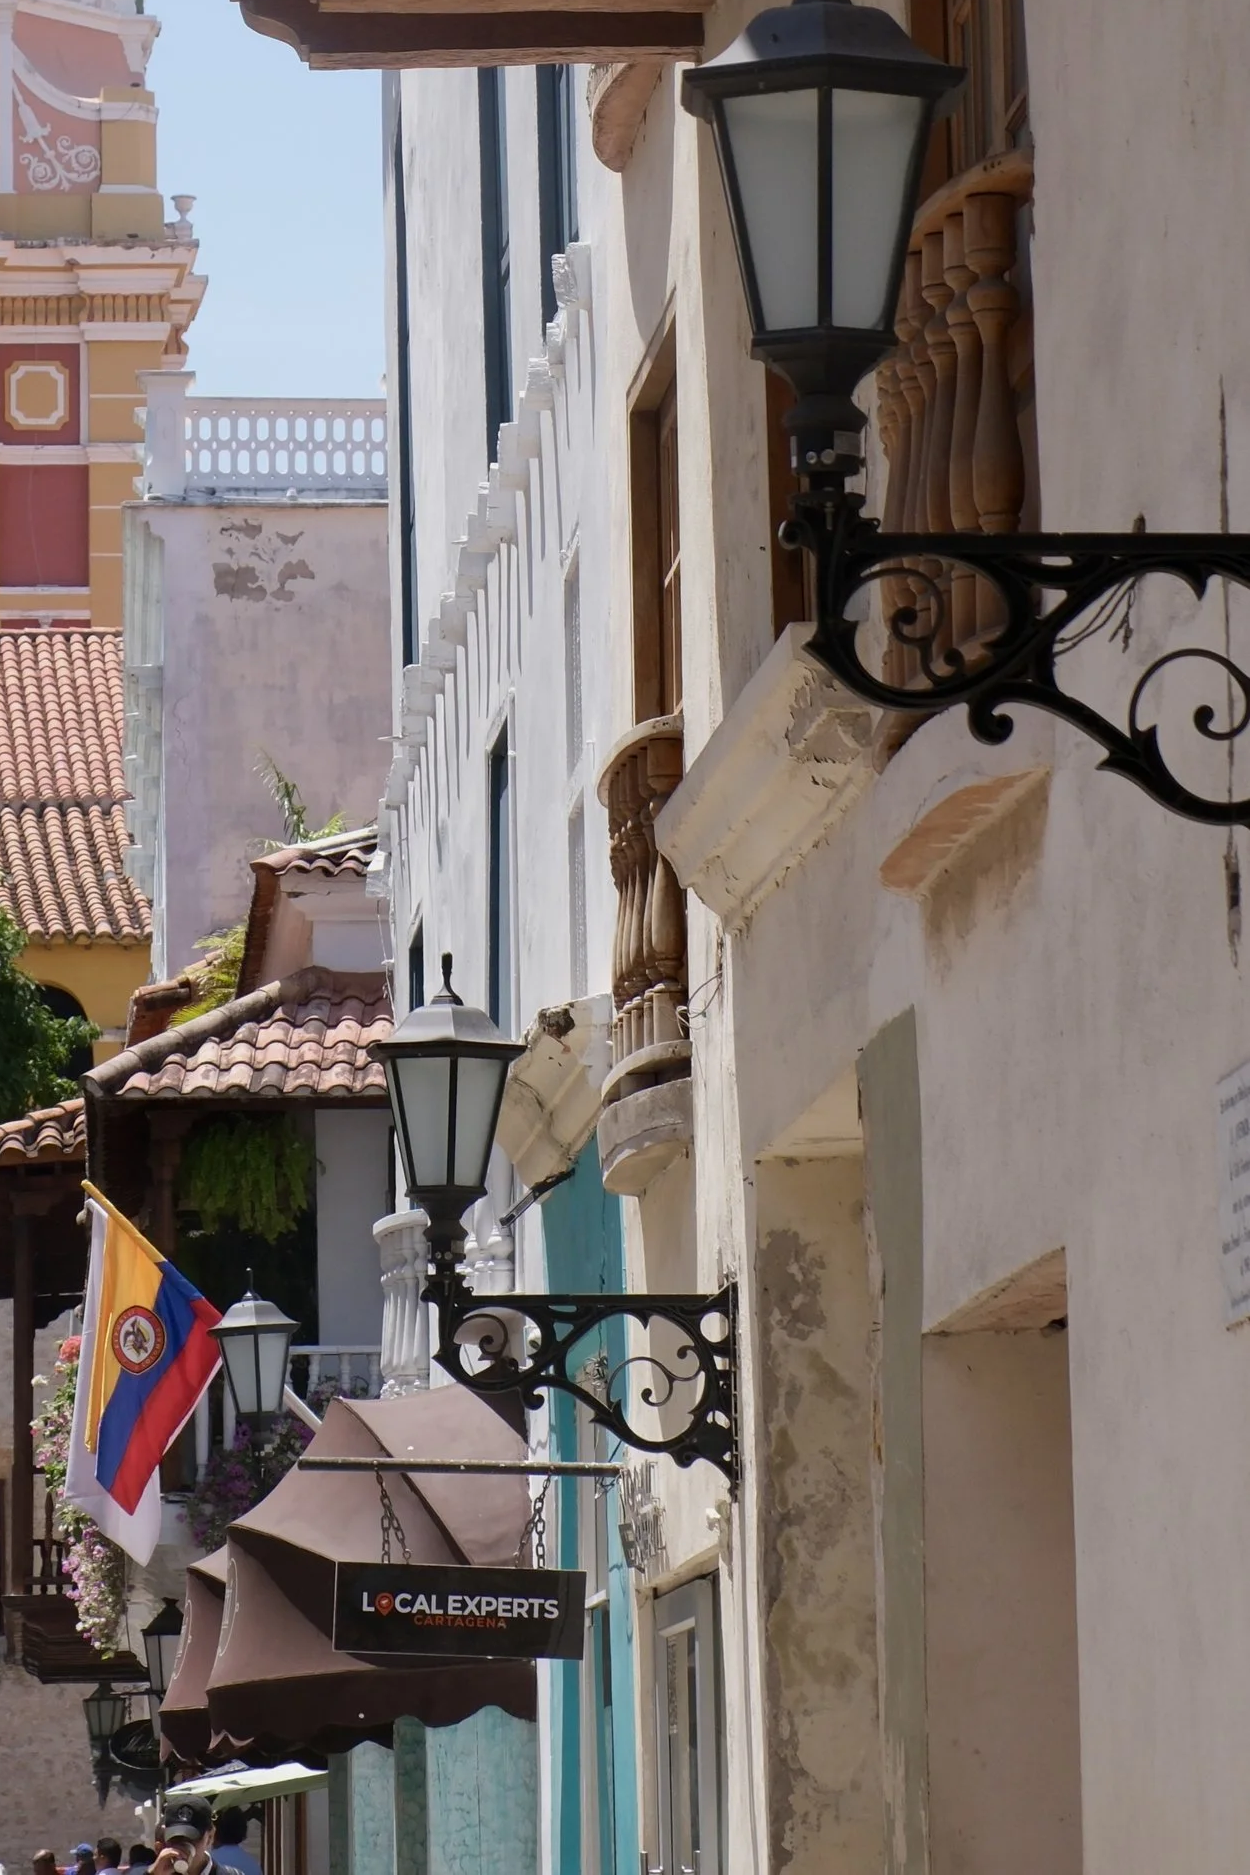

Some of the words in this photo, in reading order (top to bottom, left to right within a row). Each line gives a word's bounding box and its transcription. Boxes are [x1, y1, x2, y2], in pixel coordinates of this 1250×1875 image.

[362, 1591, 443, 1616] LOCAL
[447, 1595, 559, 1619] EXPERTS
[413, 1614, 507, 1629] CARTAGENA
